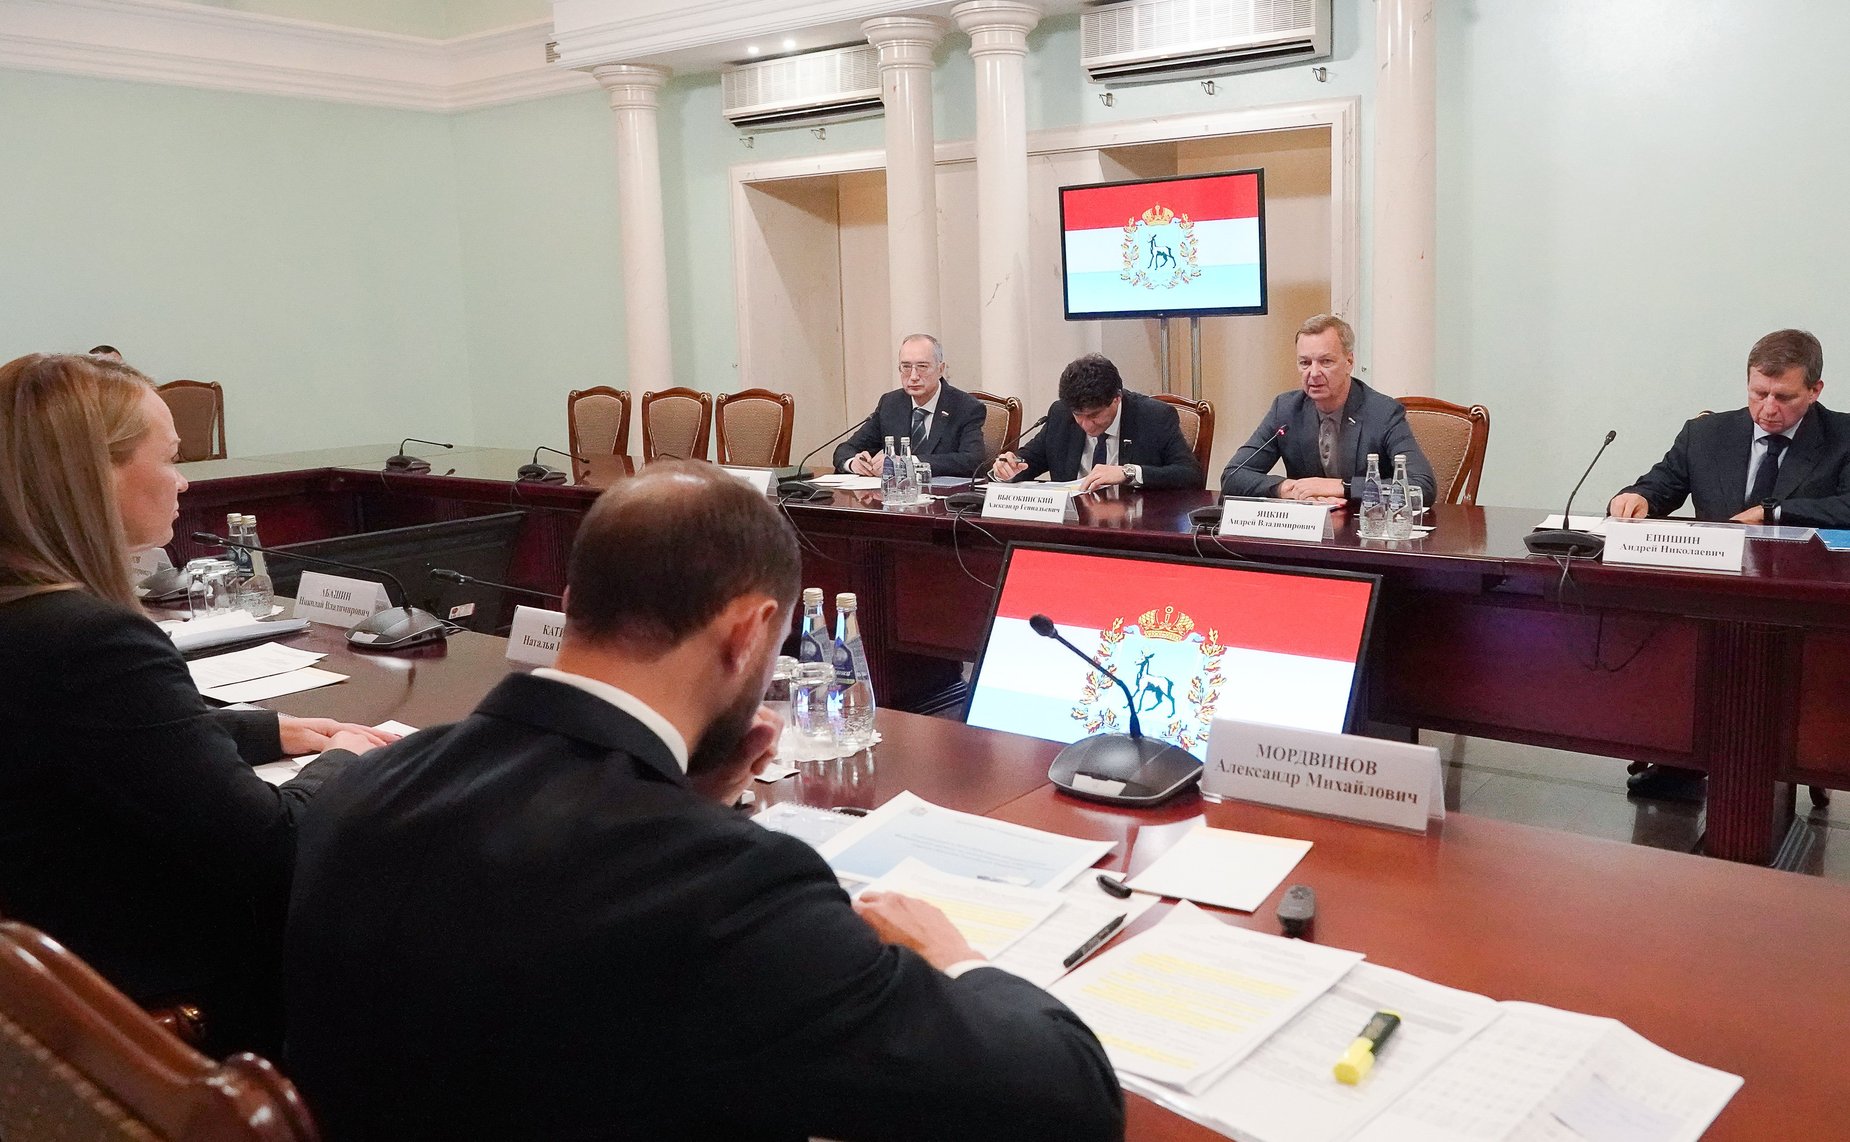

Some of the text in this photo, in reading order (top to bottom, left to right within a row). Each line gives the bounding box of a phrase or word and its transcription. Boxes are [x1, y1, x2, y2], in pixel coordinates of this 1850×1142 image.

[997, 494, 1054, 504] ВЫСОКИНСКИЙ
[1256, 510, 1289, 519] ЯЦКИН
[1229, 518, 1316, 531] Андрей Владимирович
[1645, 533, 1701, 545] ЕПИШИН
[1619, 543, 1725, 557] Андрей Николаевич
[522, 635, 555, 651] Наталья
[1256, 743, 1379, 776] МОРДВИНОВ
[1214, 758, 1419, 805] Александр Михайлович
